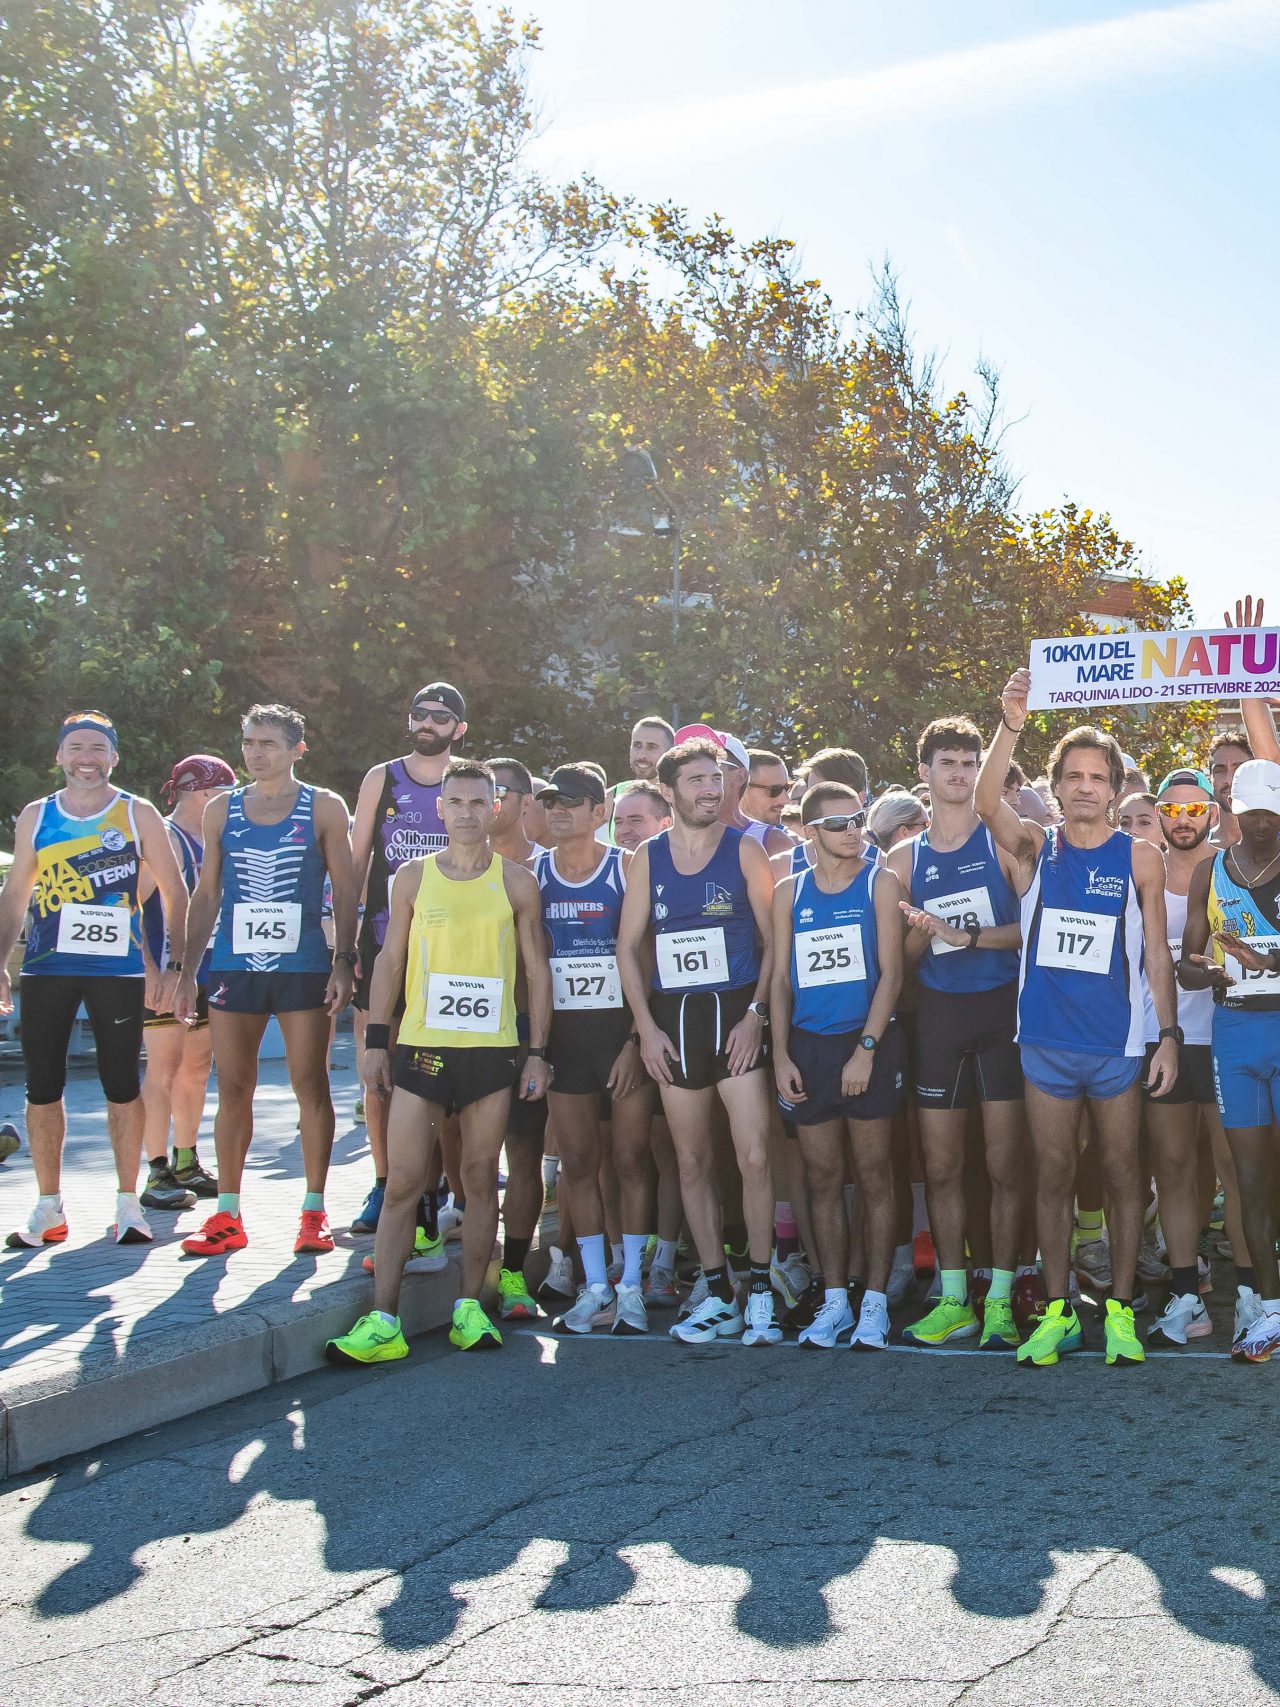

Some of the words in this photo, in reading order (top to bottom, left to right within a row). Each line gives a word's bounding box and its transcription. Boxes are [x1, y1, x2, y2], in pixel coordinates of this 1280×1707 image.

[1042, 643, 1096, 663] 10KM
[1099, 641, 1135, 660] DEL
[1076, 663, 1134, 683] MARE
[1049, 688, 1120, 704] TARQUINIA
[1122, 686, 1152, 699] LIDO
[1160, 685, 1174, 697] 21
[1177, 681, 1252, 696] SETTEMBRE
[89, 860, 136, 887] TERNI
[551, 902, 604, 919] RUNNERS
[937, 897, 972, 909] KIPRUN
[246, 922, 287, 940] 145
[1060, 915, 1097, 927] KIPRUN
[71, 922, 118, 943] 285
[672, 935, 706, 944] KIPRUN
[810, 933, 844, 943] KIPRUN
[1056, 931, 1095, 956] 117
[672, 950, 709, 973] 161
[807, 947, 851, 972] 235
[448, 980, 485, 990] KIPRUN
[565, 976, 606, 996] 127
[438, 995, 490, 1018] 266
